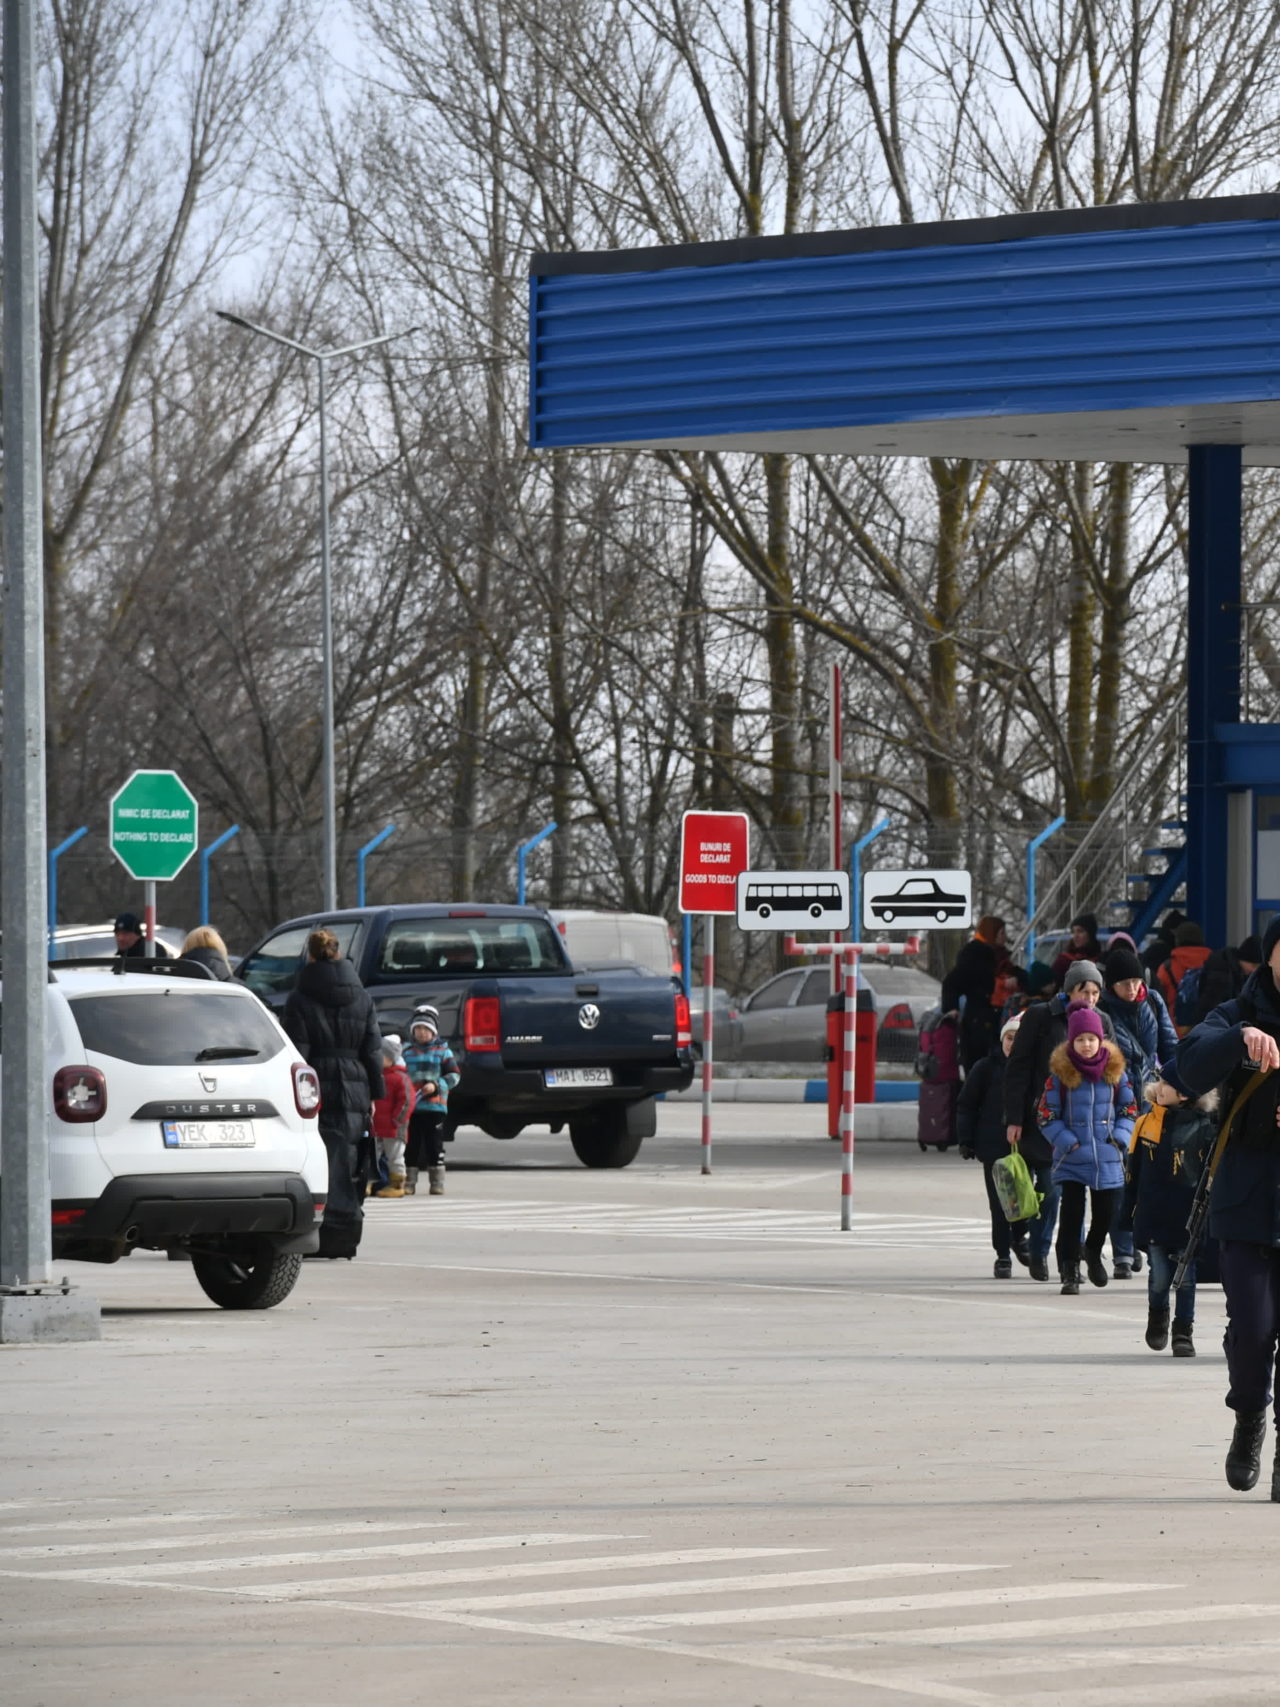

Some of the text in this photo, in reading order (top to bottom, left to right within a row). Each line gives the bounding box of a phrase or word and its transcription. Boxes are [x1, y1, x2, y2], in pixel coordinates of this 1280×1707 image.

[140, 808, 151, 818] DE
[152, 809, 190, 819] DECLARAT
[114, 832, 193, 843] NOTHING TO DECLARE
[723, 842, 731, 852] DE
[700, 853, 731, 863] DECLARAT
[685, 874, 737, 884] GOODS TO DECLA
[556, 1069, 576, 1083] MAI
[582, 1069, 609, 1082] 8521
[165, 1104, 257, 1113] DUSTER
[177, 1124, 208, 1142] YEK
[218, 1124, 246, 1142] 323
